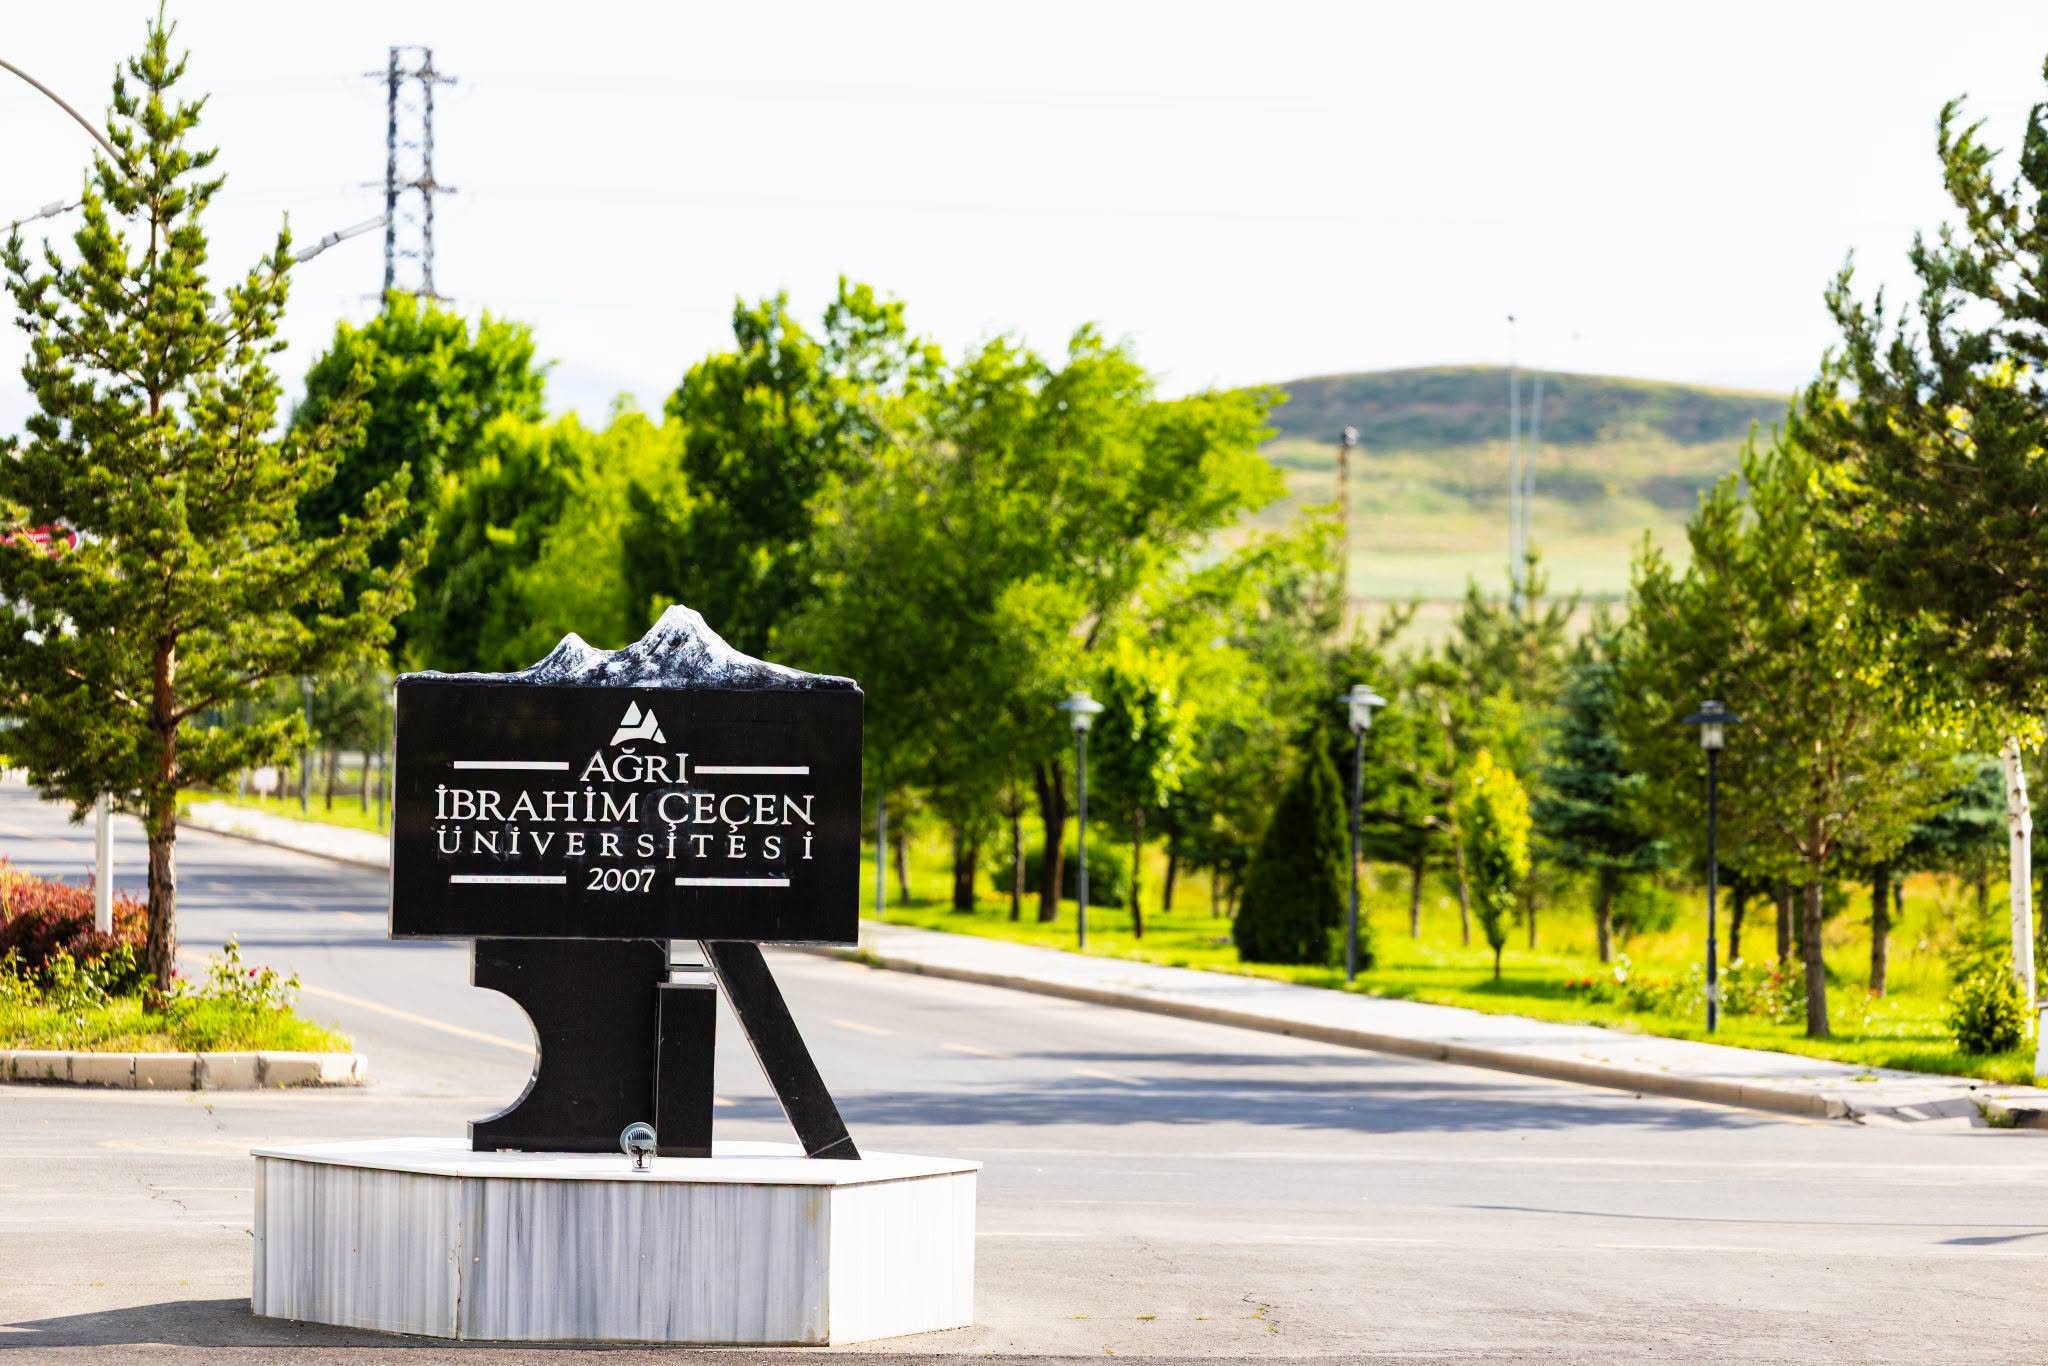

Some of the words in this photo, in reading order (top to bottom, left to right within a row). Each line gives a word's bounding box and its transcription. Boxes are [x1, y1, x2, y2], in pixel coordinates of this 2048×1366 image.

[579, 747, 690, 784] AĞRI
[434, 783, 639, 823] İBRAHİM
[657, 792, 815, 833] ÇEÇEN
[436, 824, 815, 860] ÜNİVERSİTESİ
[586, 867, 656, 893] 2007
